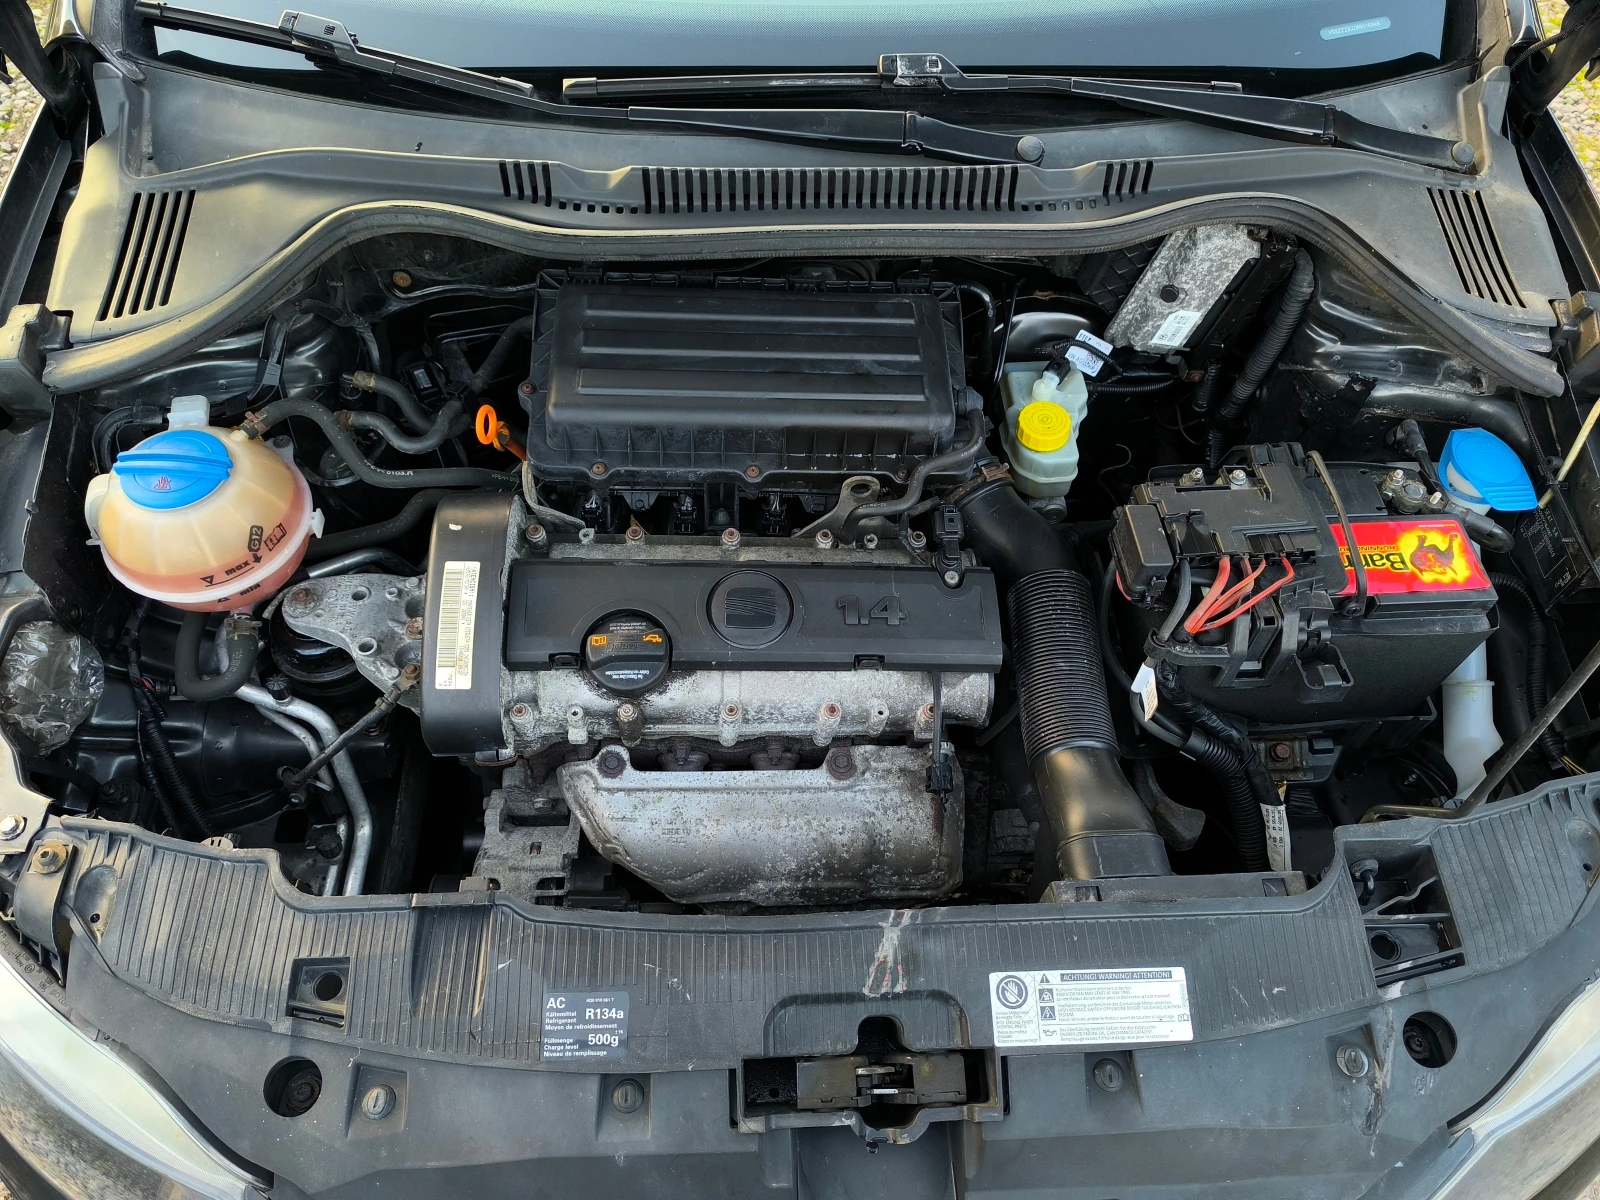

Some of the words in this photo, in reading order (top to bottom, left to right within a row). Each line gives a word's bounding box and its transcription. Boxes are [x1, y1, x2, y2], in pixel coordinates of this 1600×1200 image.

[251, 527, 262, 550] G12
[225, 560, 250, 576] max
[240, 583, 261, 596] min
[836, 595, 906, 626] 1.4
[1133, 971, 1170, 979] ATTENTION!
[546, 997, 566, 1009] AC
[585, 1008, 624, 1020] R134a
[587, 1033, 619, 1047] 500g
